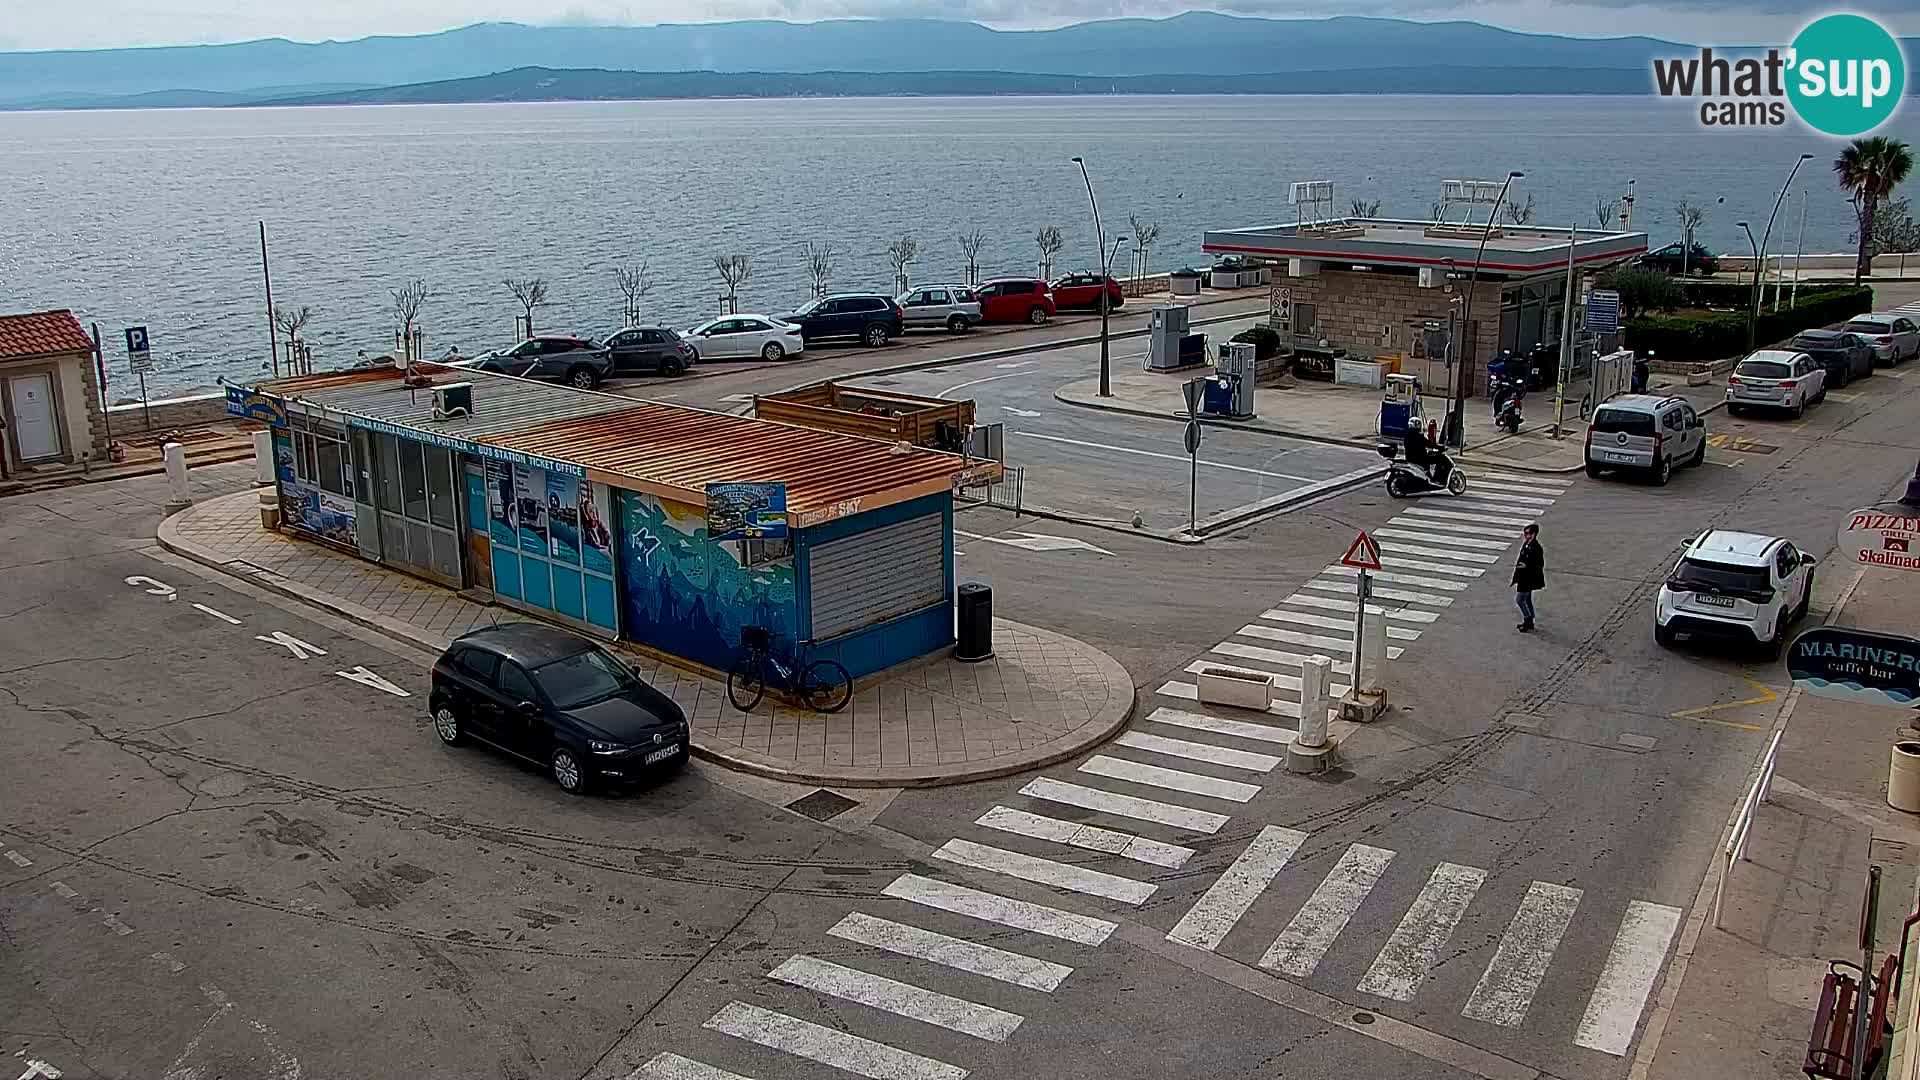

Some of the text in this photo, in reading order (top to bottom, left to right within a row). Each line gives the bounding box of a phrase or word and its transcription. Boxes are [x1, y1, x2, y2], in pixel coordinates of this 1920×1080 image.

[130, 330, 143, 349] P
[437, 436, 468, 451] POSTAJA
[478, 445, 493, 457] BUS
[494, 449, 526, 464] STATION
[528, 456, 554, 471] TICKET
[555, 462, 582, 477] OFFICE
[1880, 530, 1916, 541] GRILL
[1827, 661, 1896, 680] caffe bar
